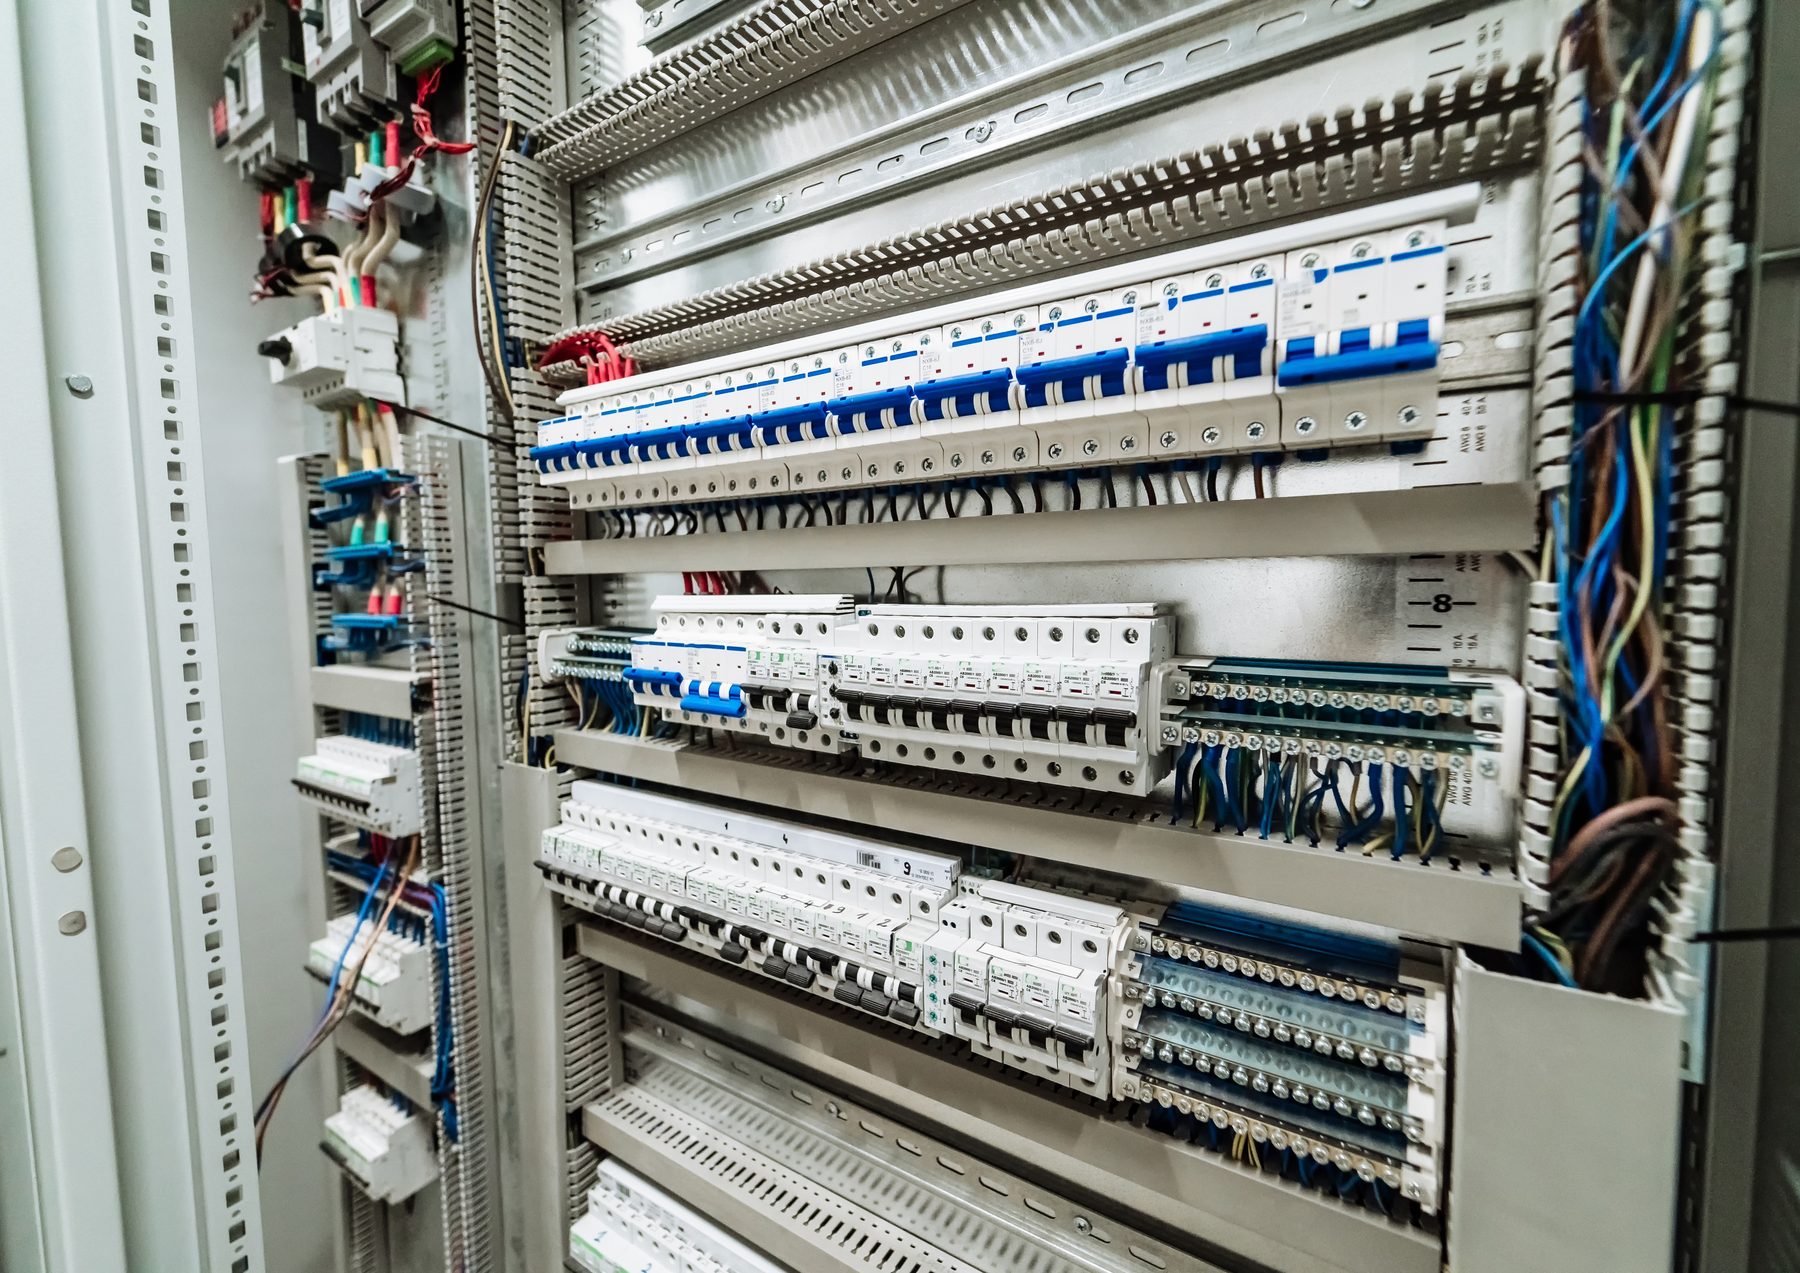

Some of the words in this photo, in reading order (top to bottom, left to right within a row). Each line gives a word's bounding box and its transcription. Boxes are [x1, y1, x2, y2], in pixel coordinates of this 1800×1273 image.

[1460, 433, 1470, 453] AWG
[1475, 432, 1486, 452] AWG
[1432, 594, 1452, 613] 8
[1453, 641, 1463, 649] 10
[1448, 785, 1457, 804] AWG
[1462, 786, 1472, 806] AWG
[877, 919, 891, 927] 2
